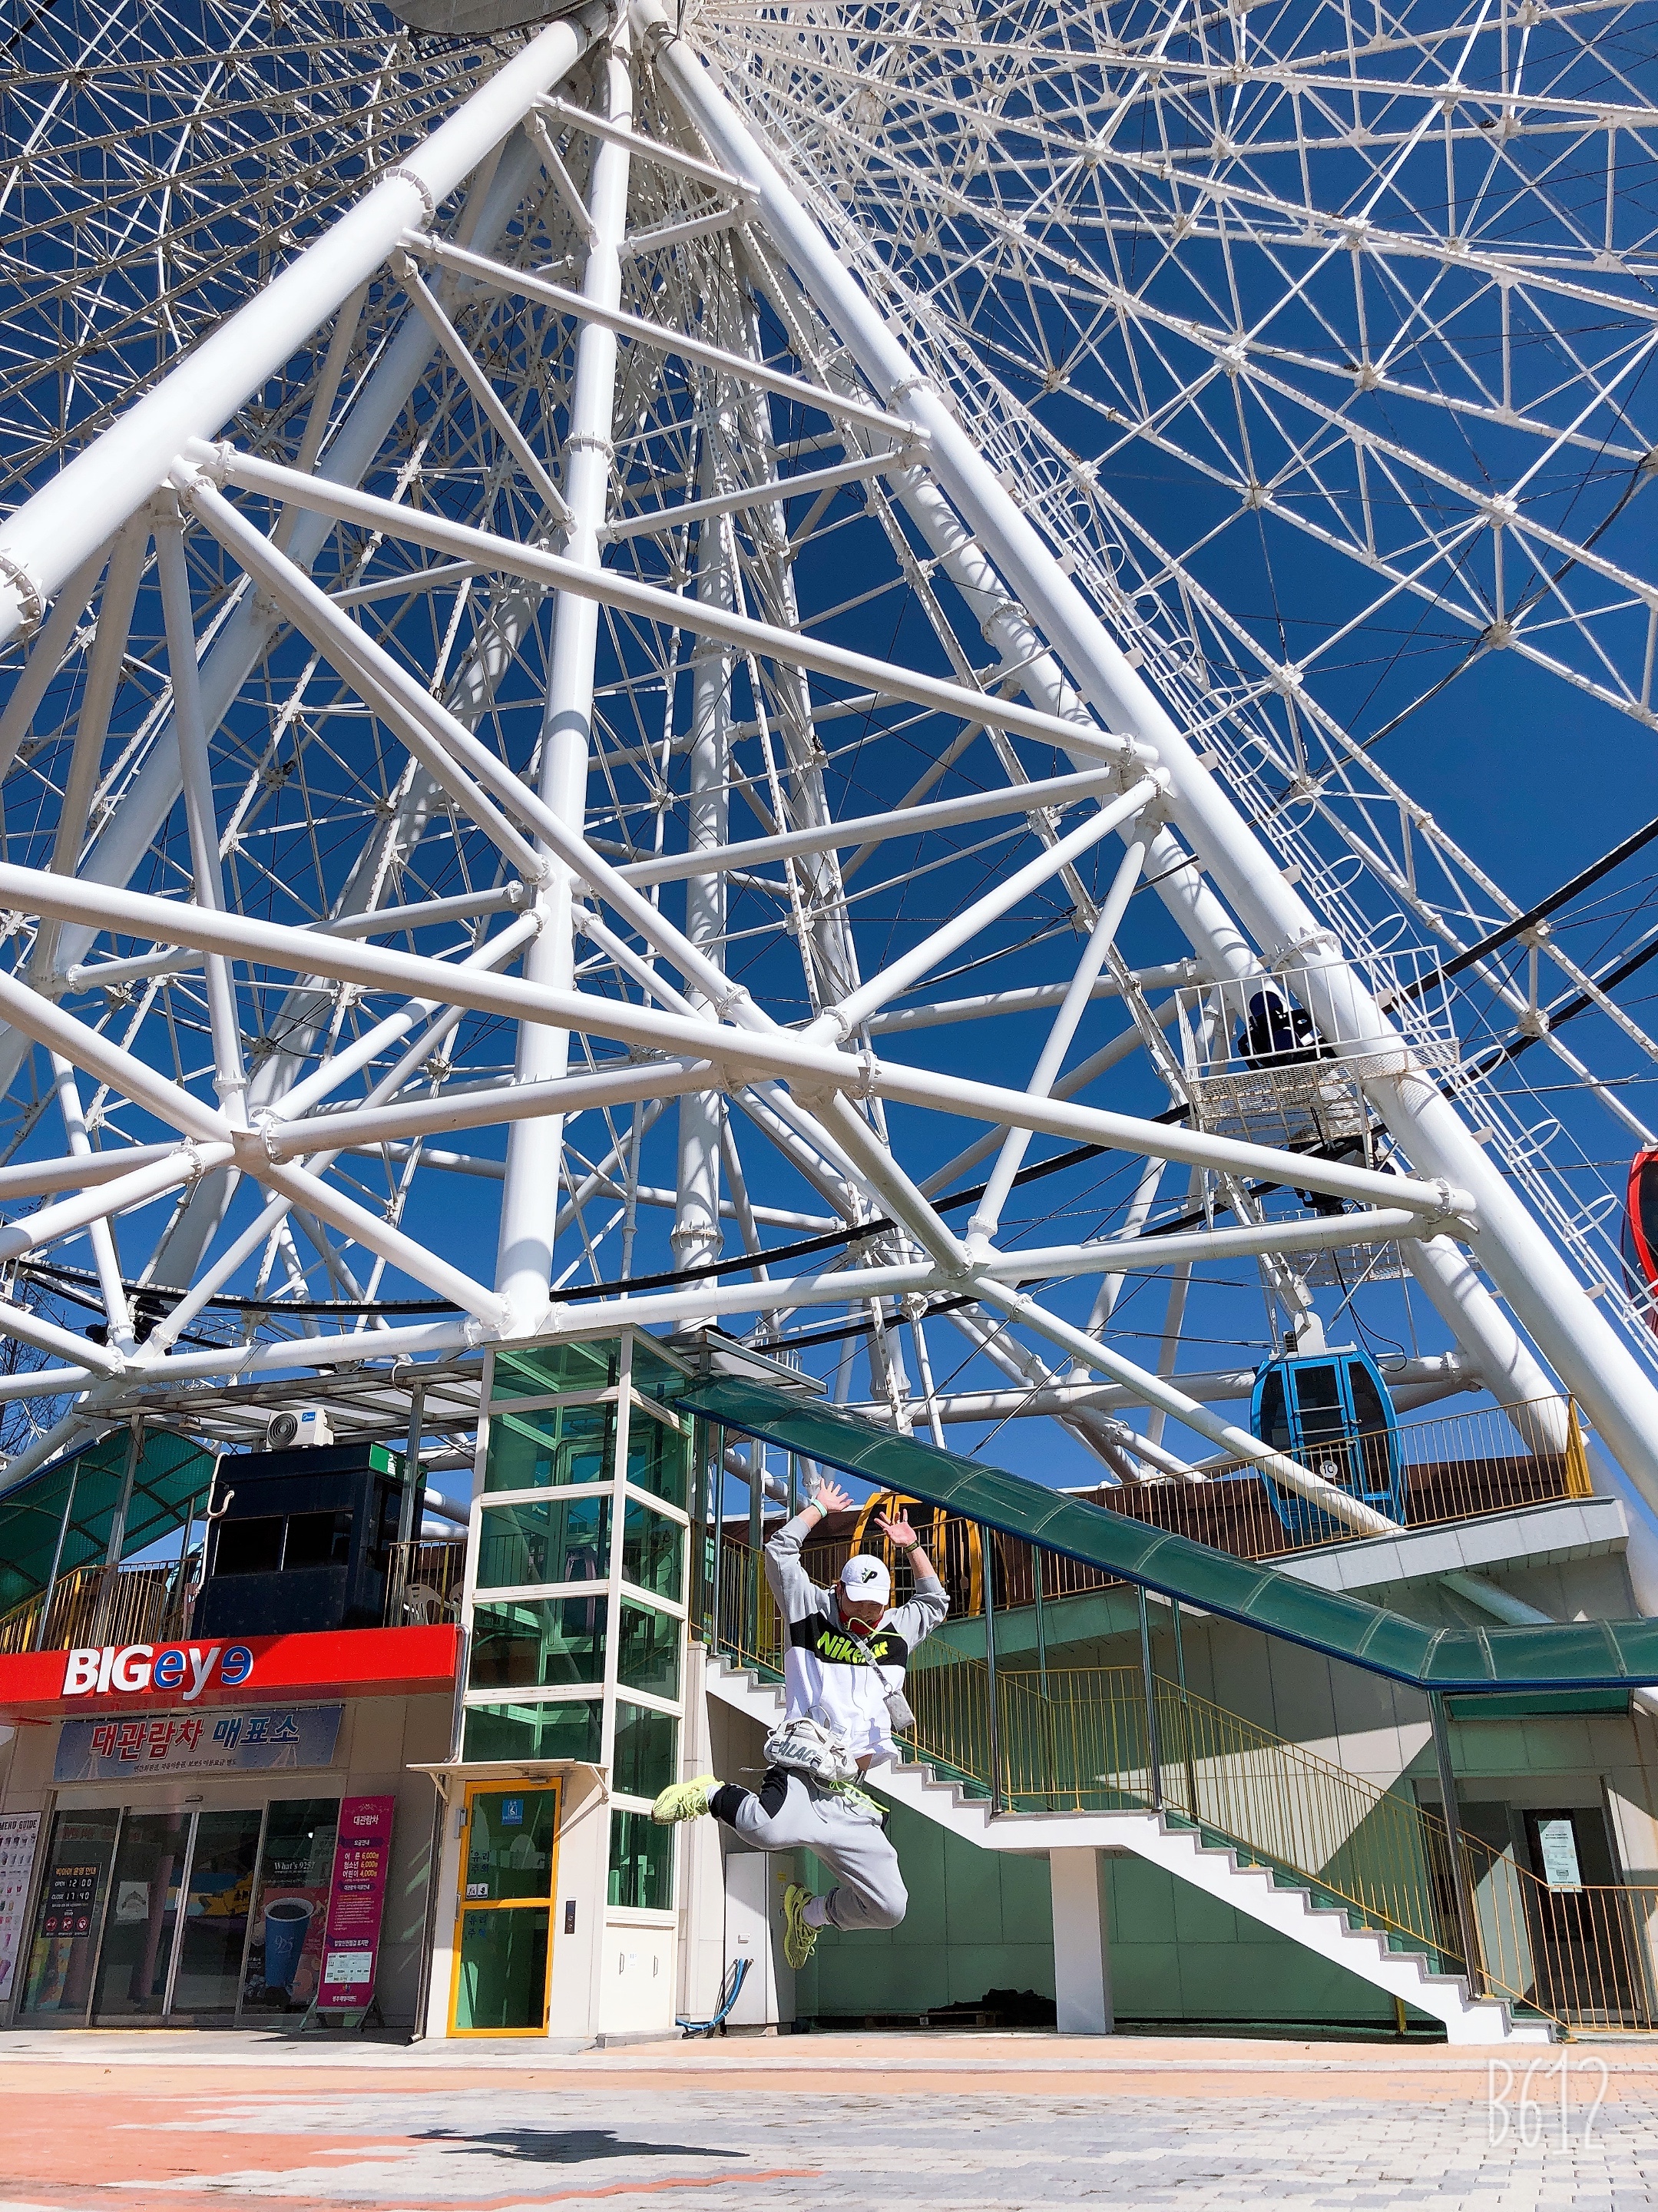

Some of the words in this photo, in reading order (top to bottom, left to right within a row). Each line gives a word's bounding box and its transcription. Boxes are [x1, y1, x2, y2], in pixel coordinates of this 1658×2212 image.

[91, 1719, 204, 1762] 대관람차
[211, 1714, 300, 1750] 매표소
[19, 1820, 38, 1830] GUIDE
[353, 1815, 379, 1826] 대관람차
[274, 1862, 299, 1870] What's
[343, 1861, 359, 1869] 청소년
[85, 1866, 97, 1875] 안내
[343, 1869, 359, 1879] 어린이
